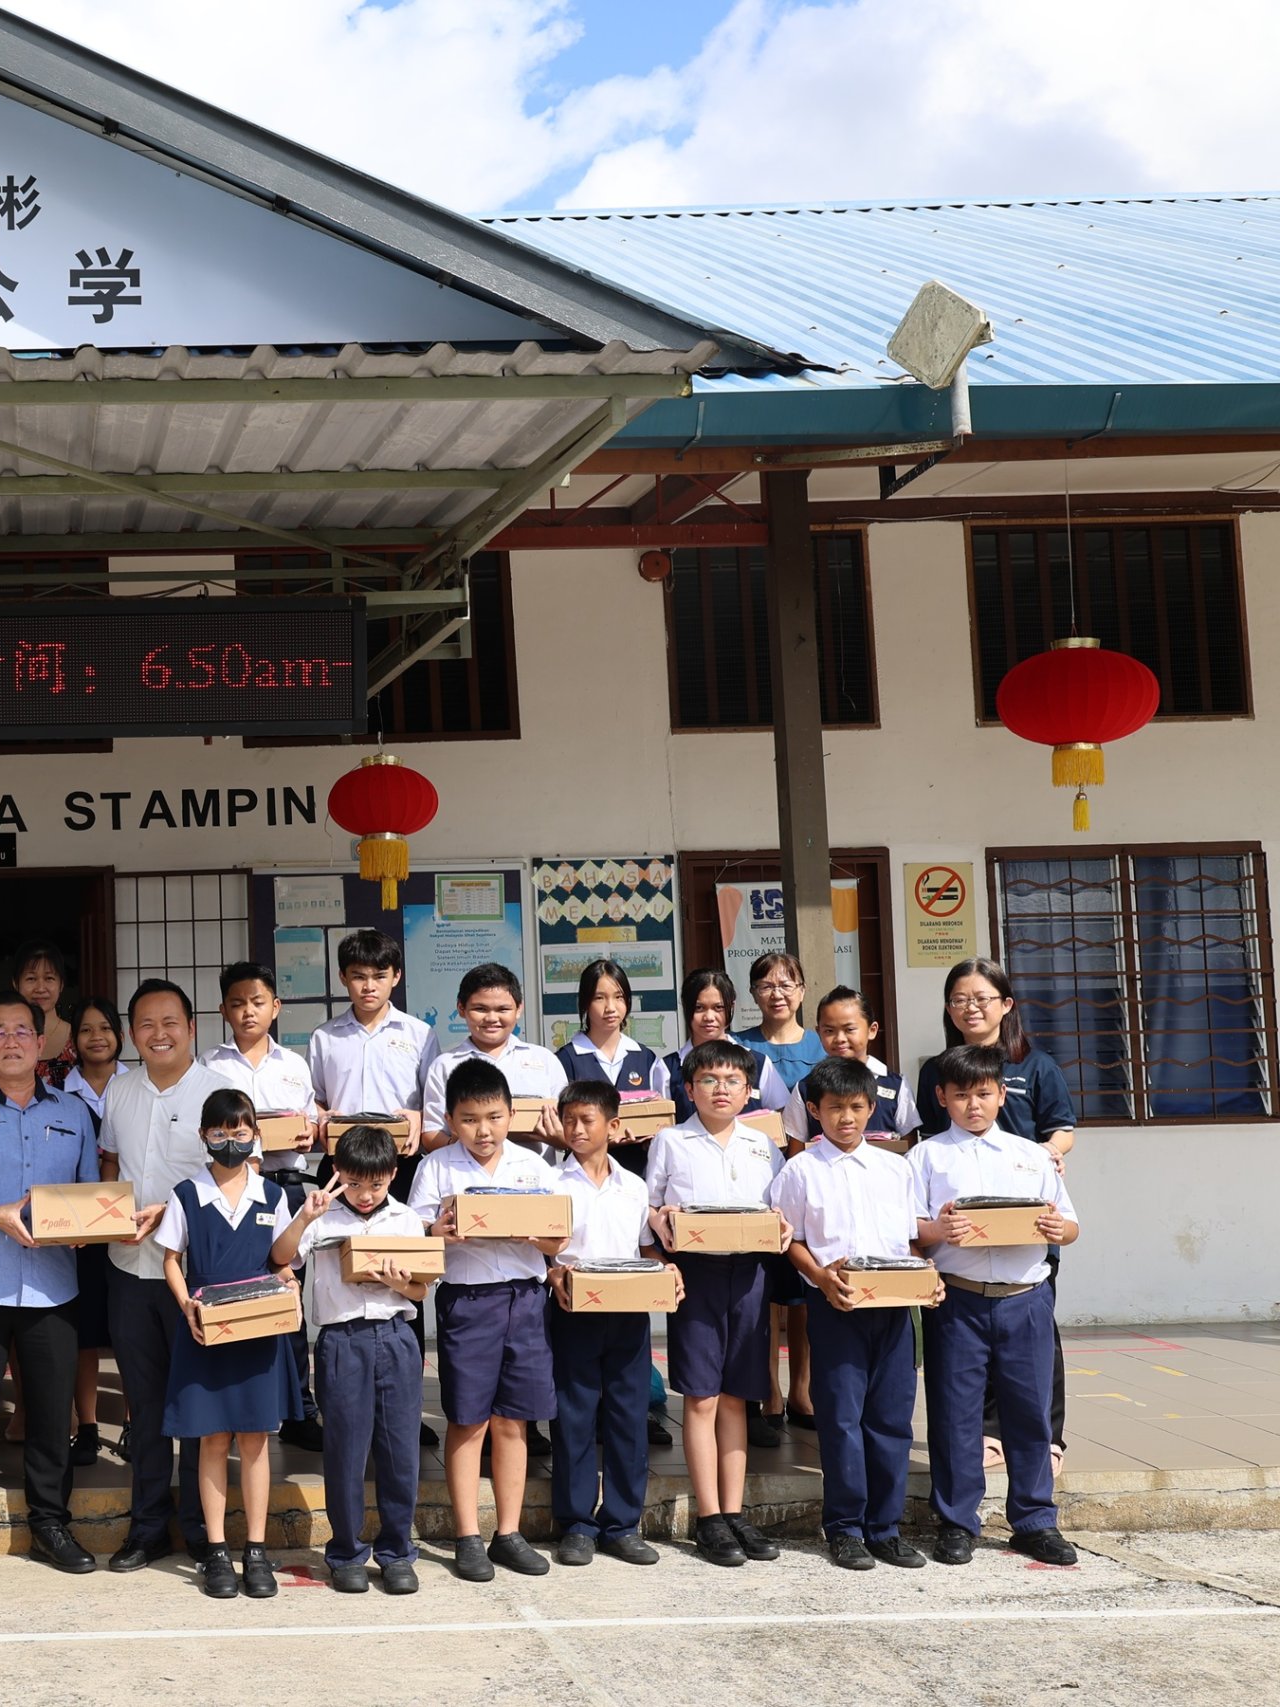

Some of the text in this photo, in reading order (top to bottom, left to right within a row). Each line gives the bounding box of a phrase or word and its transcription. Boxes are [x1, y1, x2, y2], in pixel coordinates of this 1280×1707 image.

[63, 785, 317, 831] STAMPIN
[542, 869, 663, 889] BAHASA
[545, 903, 665, 920] MELAYU
[47, 1217, 71, 1231] pallas
